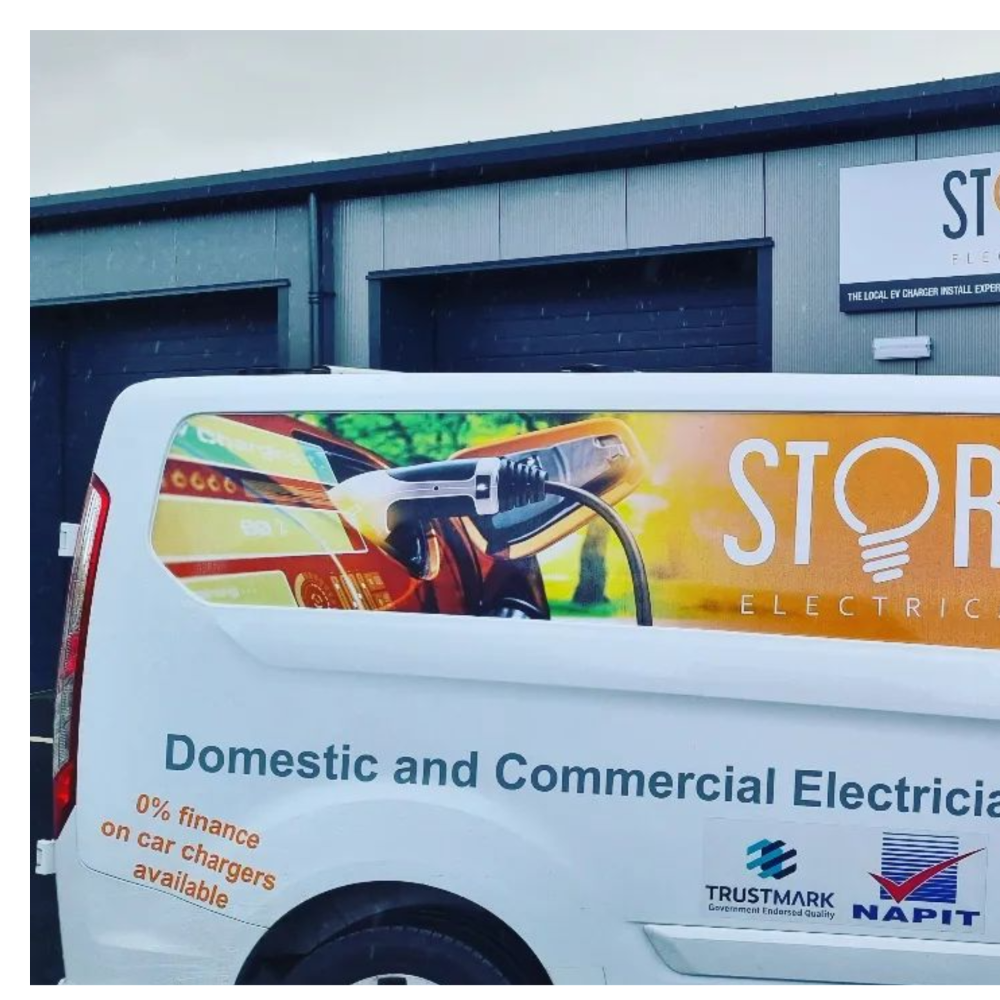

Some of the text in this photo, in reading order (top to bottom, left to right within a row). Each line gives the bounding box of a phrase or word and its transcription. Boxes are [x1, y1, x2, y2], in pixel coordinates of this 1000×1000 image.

[848, 292, 862, 302] THE
[863, 290, 888, 301] LOCAL
[890, 289, 901, 299] EV
[902, 287, 939, 298] CHARGER
[940, 285, 972, 296] INSTALL
[165, 733, 378, 782] Domestic
[393, 751, 478, 788] and
[495, 752, 775, 804] Commercial
[135, 793, 261, 850] 0% finance
[100, 821, 276, 892] on car chargers
[132, 862, 229, 909] available
[705, 884, 835, 908] TRUSTMARK
[708, 903, 836, 920] Government Endorsed Quality
[852, 903, 981, 927] NAPIT
